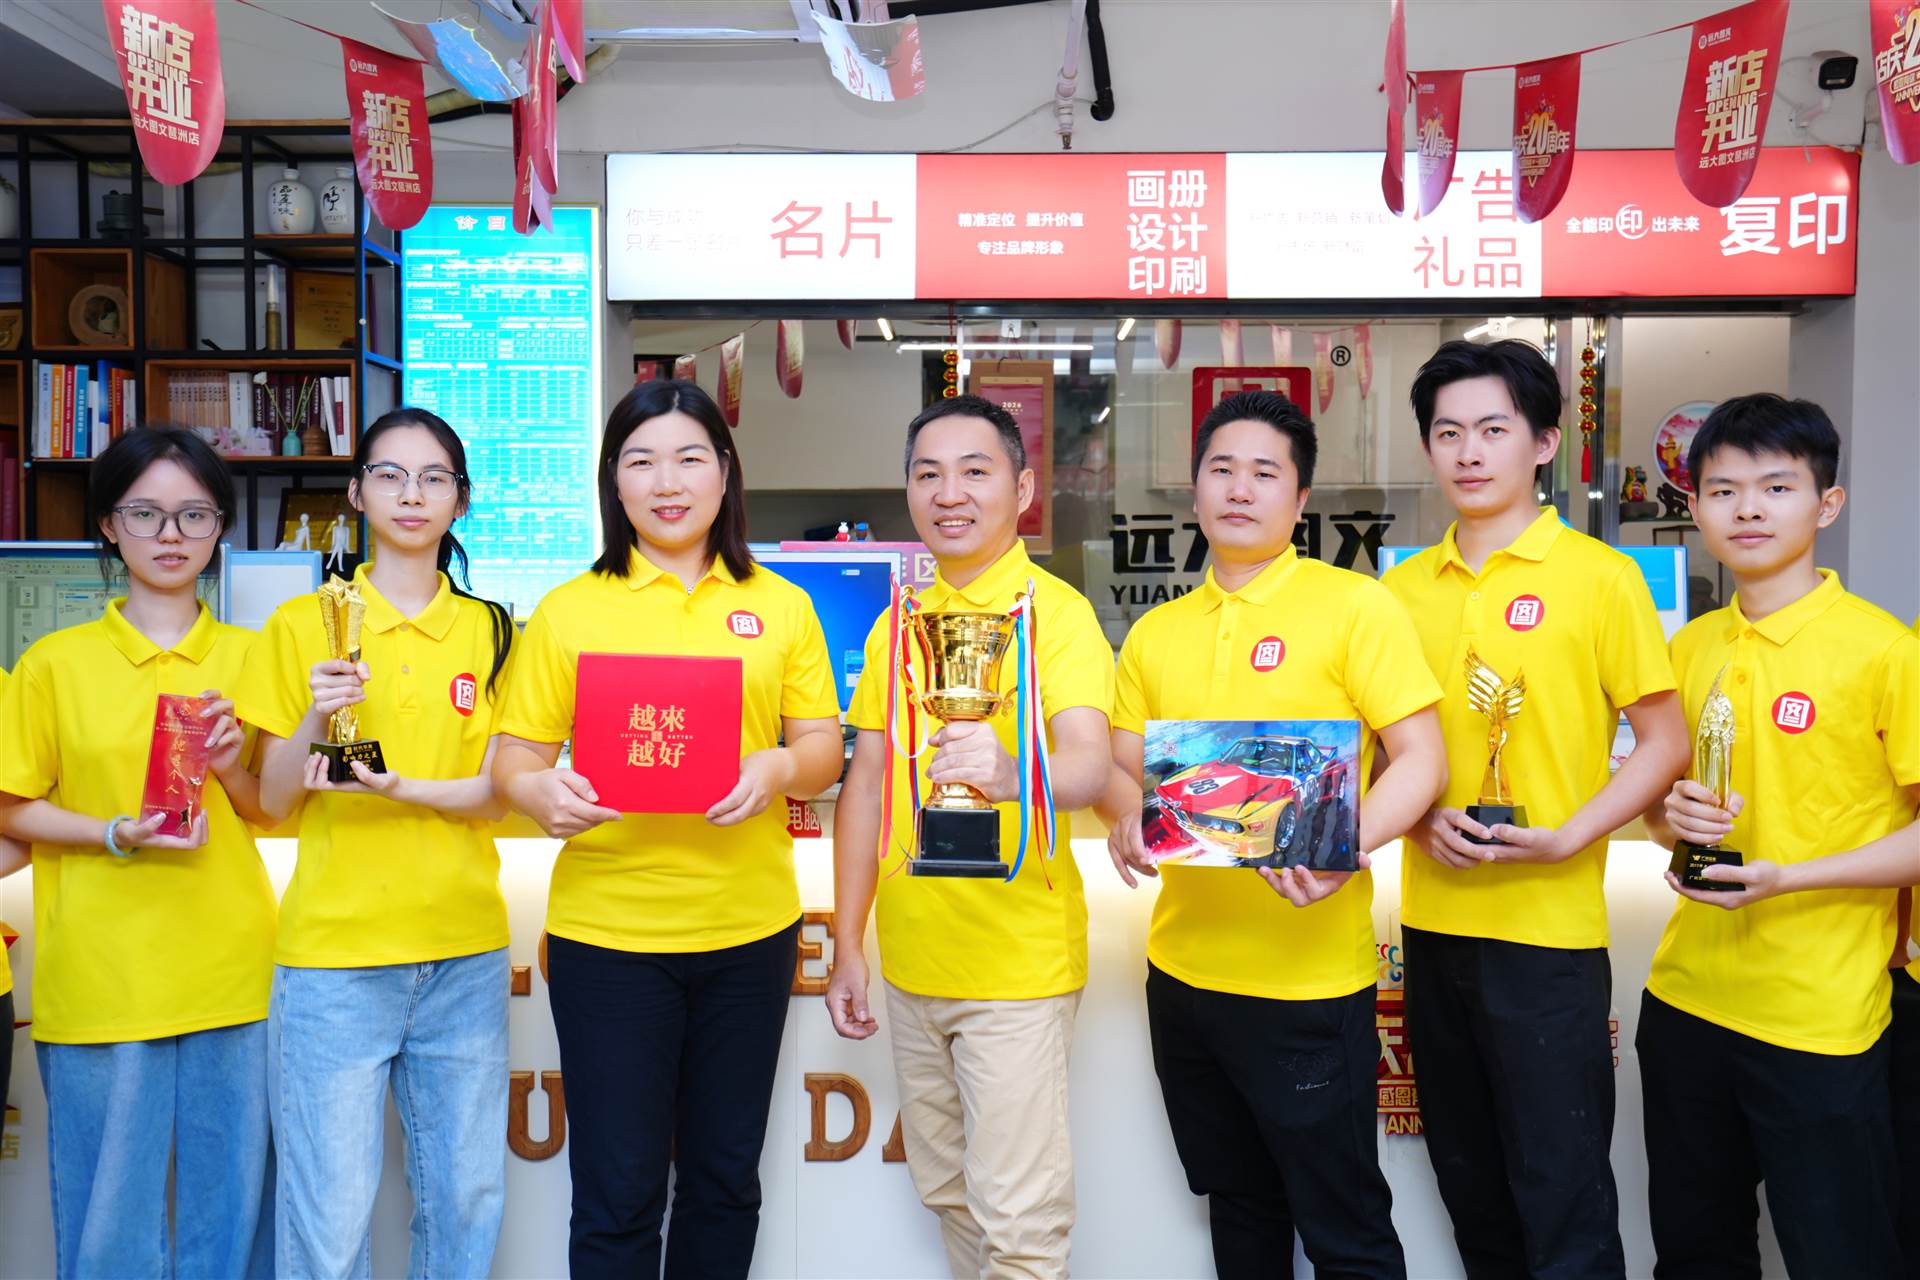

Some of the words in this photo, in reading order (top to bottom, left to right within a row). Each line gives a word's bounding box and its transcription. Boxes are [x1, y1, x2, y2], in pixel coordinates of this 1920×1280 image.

[120, 4, 194, 72] 新店
[128, 51, 189, 84] OPENING
[1705, 48, 1768, 102] 新店
[127, 64, 199, 129] 开业
[362, 89, 411, 133] 新店
[1708, 91, 1758, 115] OPENING
[368, 127, 410, 145] OPENING
[1701, 104, 1758, 154] 开业
[367, 139, 420, 180] 开业
[1126, 169, 1208, 208] 画册
[770, 199, 893, 260] 名片
[957, 212, 1017, 228] 精准定位
[1025, 212, 1085, 228] 提升价值
[1126, 211, 1208, 252] 设计
[1565, 216, 1614, 234] 全能印
[1651, 216, 1700, 233] 出未来
[1719, 192, 1848, 257] 复印
[976, 240, 1064, 256] 专注品牌形象
[1413, 236, 1522, 289] 礼品
[1127, 255, 1208, 295] 印刷
[1002, 401, 1022, 409] 2026
[1110, 584, 1193, 605] YUAN
[628, 703, 686, 732] 越來
[626, 741, 686, 768] 越好
[788, 804, 820, 831] 电脑
